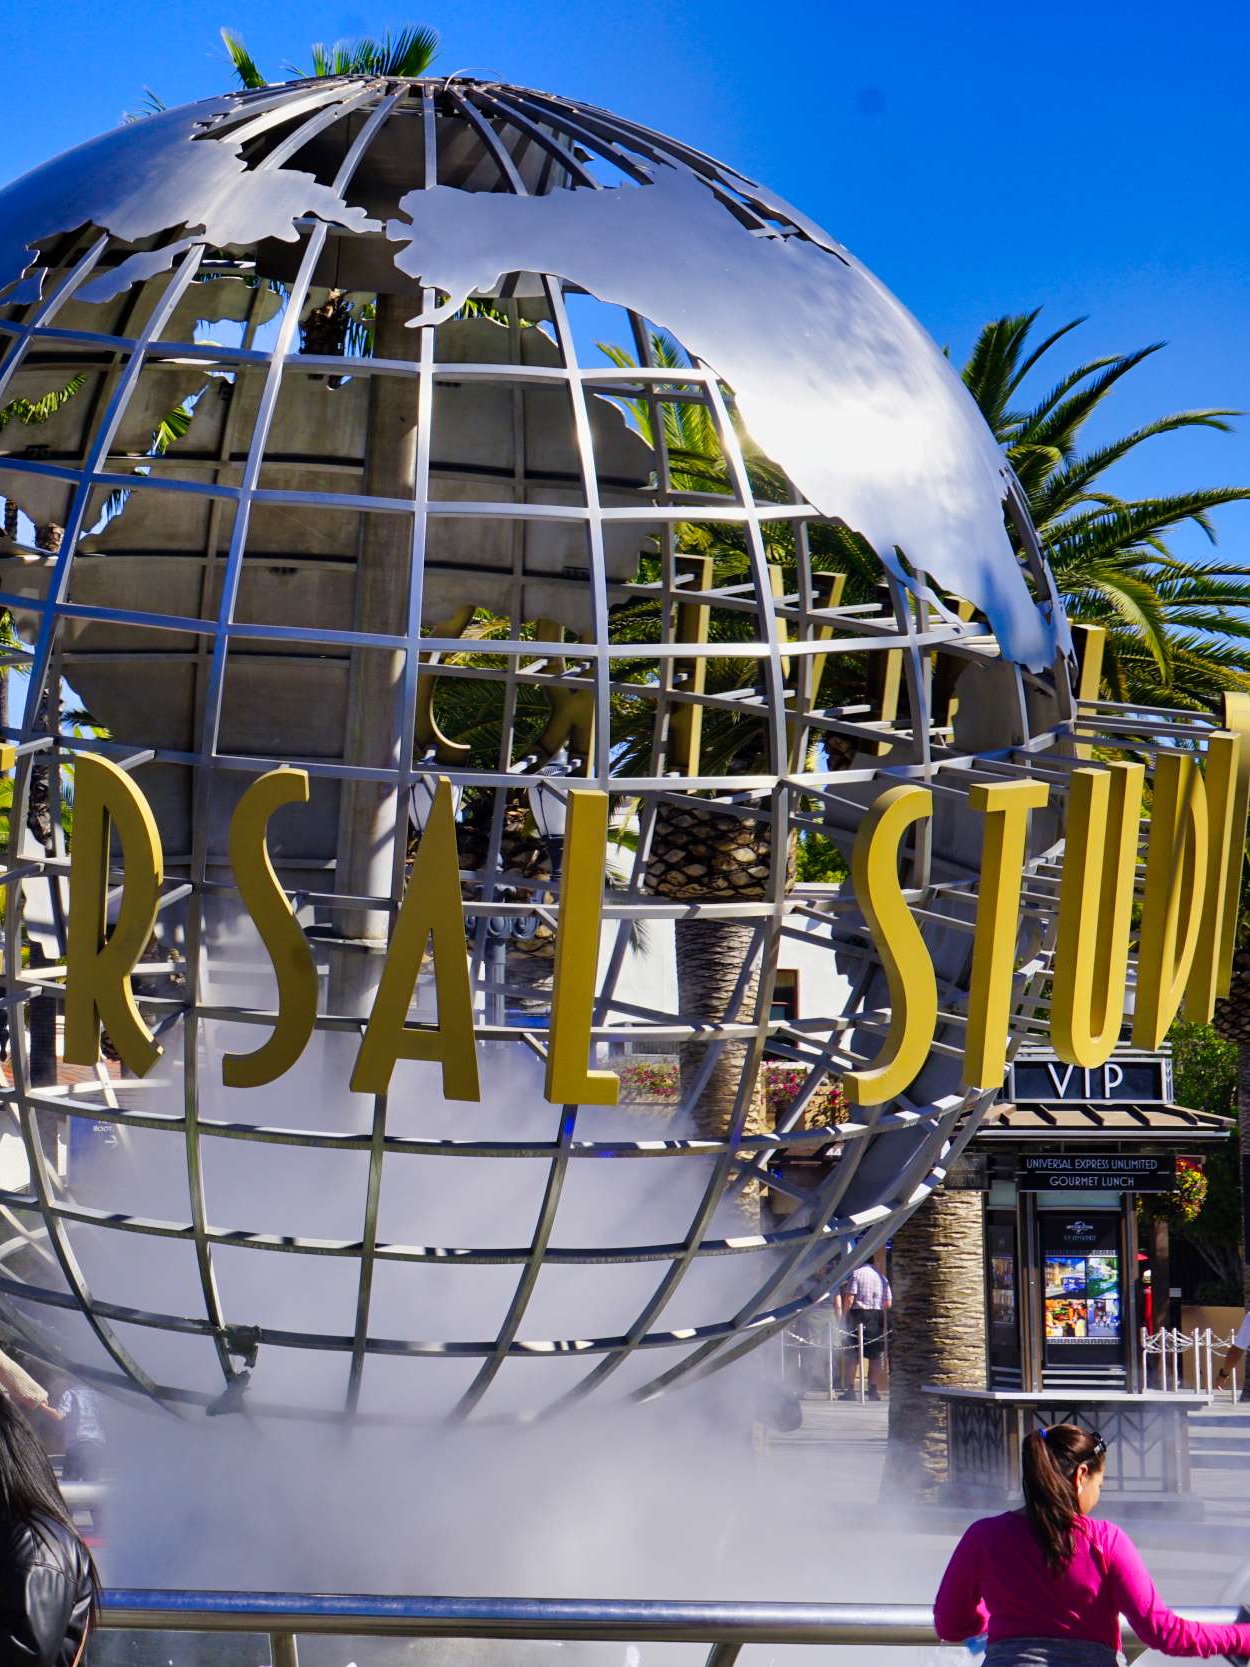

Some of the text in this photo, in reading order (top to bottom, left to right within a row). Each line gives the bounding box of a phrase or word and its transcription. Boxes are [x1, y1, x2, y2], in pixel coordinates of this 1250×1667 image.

[1047, 1062, 1124, 1098] VIP
[1026, 1158, 1158, 1170] UNIVERSAL EXPRESS UNLIMITED
[1049, 1176, 1135, 1187] GOURMET LUNCH
